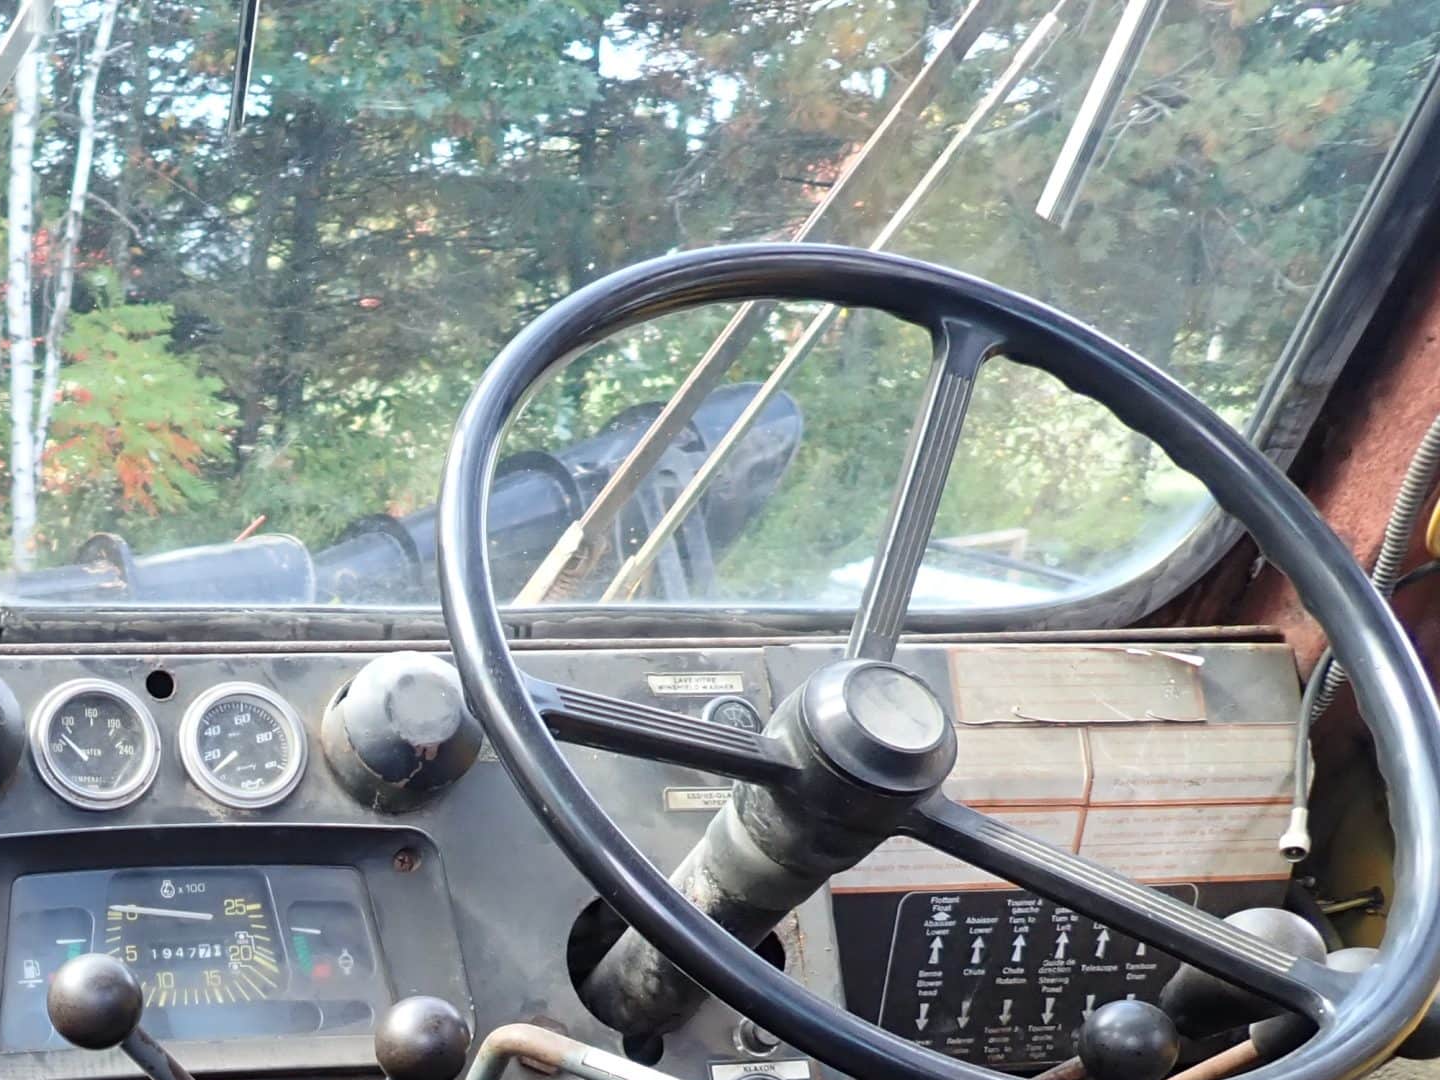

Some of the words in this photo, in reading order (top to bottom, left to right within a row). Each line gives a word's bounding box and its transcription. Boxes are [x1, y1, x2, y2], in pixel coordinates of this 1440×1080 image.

[84, 707, 98, 718] 160
[106, 718, 121, 729] 190
[233, 713, 252, 726] 60
[204, 725, 222, 737] 40
[256, 731, 274, 744] 80
[118, 745, 135, 756] 240
[204, 749, 222, 761] 20
[185, 883, 206, 894] 100
[223, 898, 247, 915] 25
[932, 904, 952, 912] Float
[1011, 906, 1040, 914] gauche
[1027, 916, 1036, 924] to
[926, 928, 950, 936] Lower
[968, 926, 993, 934] Lower
[1013, 925, 1030, 933] Left
[1056, 924, 1072, 932] Left
[126, 945, 138, 961] 5
[229, 944, 252, 961] 20
[963, 968, 986, 976] Chute
[1003, 967, 1025, 975] Chute
[157, 971, 175, 989] 10
[203, 969, 222, 986] 15
[1125, 973, 1148, 981] Drum
[916, 979, 943, 987] Blower
[918, 989, 938, 997] head
[742, 1064, 776, 1073] KLAXON
